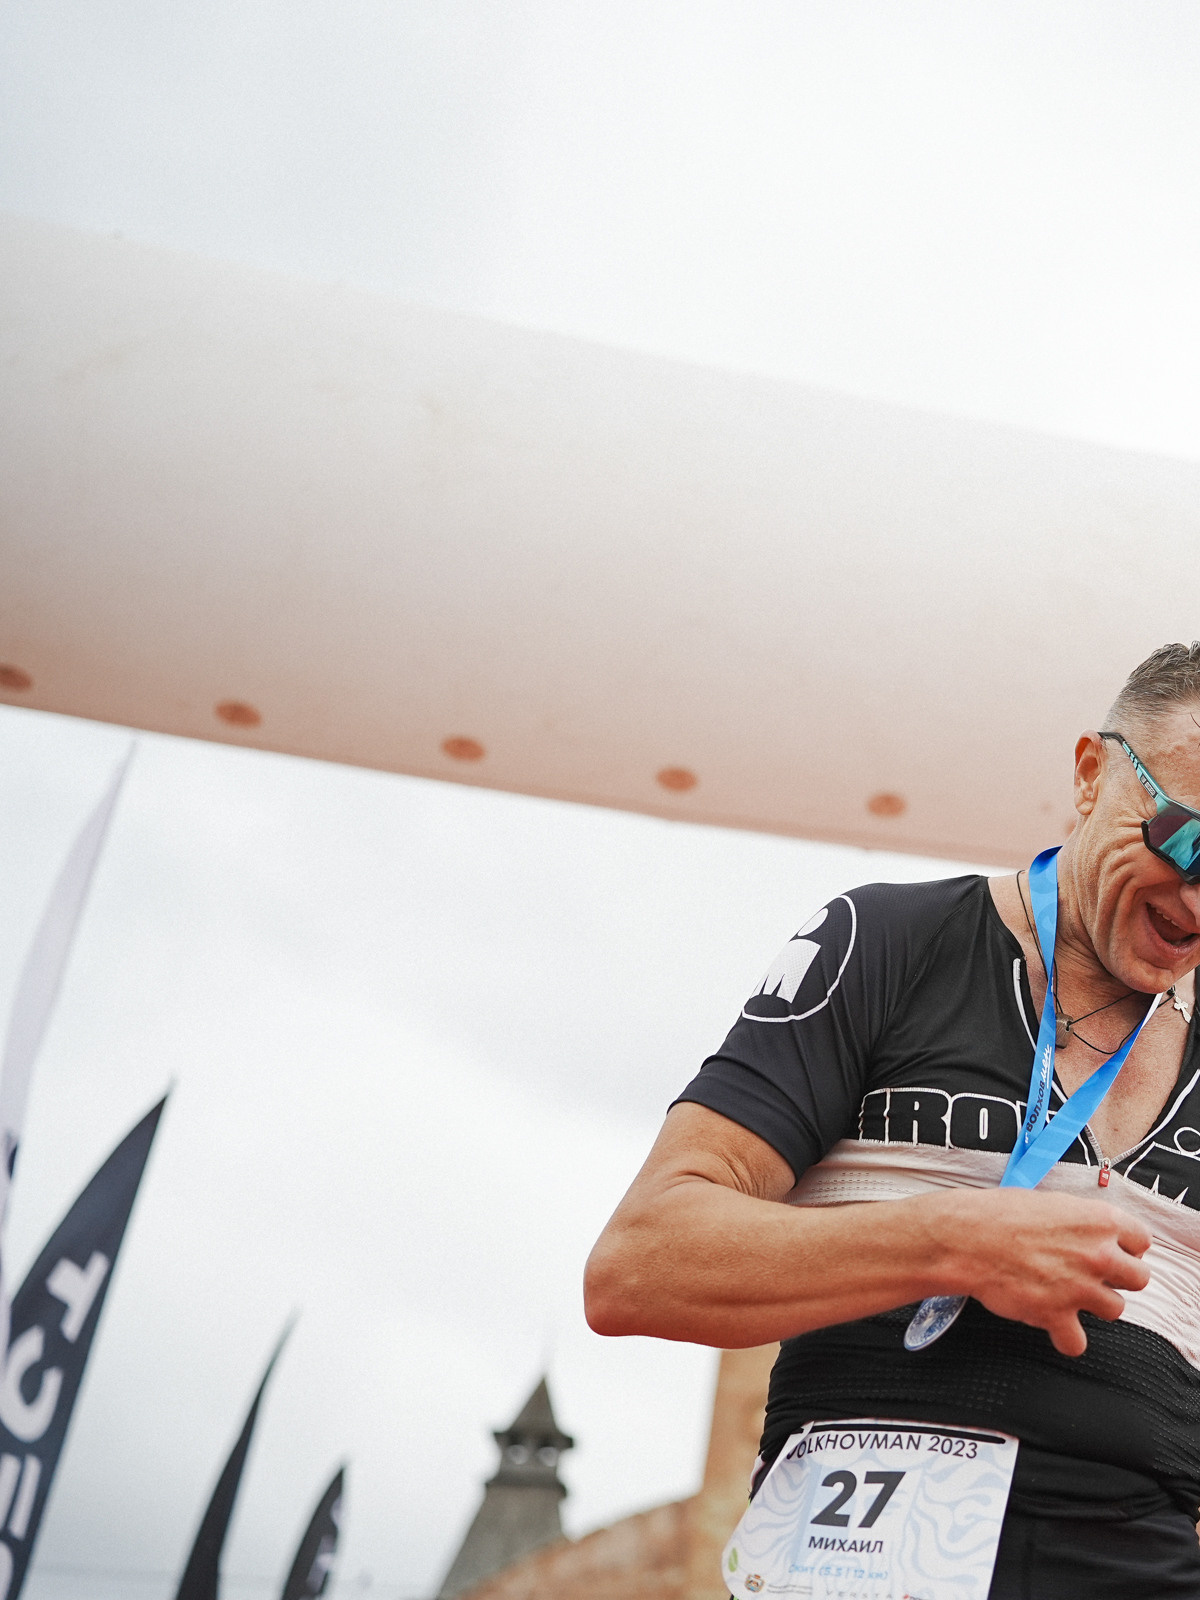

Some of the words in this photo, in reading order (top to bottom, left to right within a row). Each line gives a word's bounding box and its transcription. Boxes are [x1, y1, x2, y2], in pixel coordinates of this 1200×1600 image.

[927, 1435, 978, 1460] 2023
[810, 1469, 907, 1529] 27
[807, 1535, 884, 1555] МИХАИЛ
